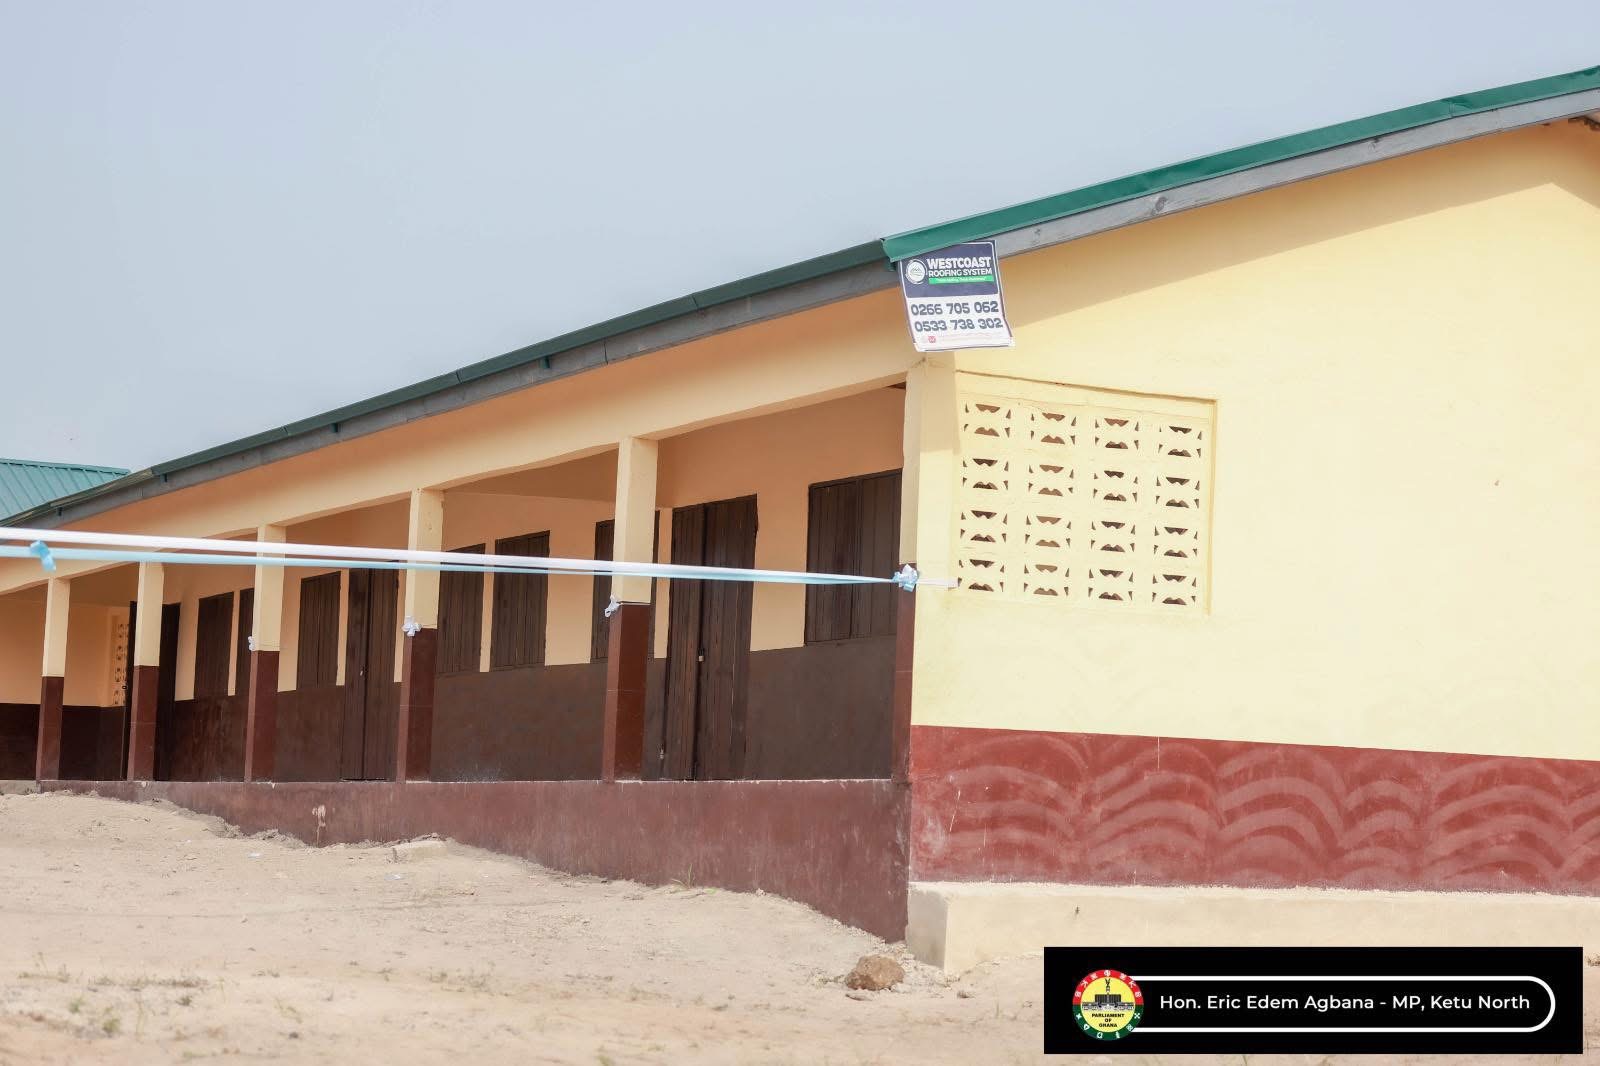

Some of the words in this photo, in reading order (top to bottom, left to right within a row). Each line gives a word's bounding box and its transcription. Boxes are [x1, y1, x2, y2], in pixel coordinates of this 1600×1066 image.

[926, 257, 991, 269] WESTCOAST
[928, 269, 962, 278] ROOFING
[963, 268, 992, 276] SYSTEM
[911, 304, 943, 316] 0266
[946, 303, 970, 315] 705
[974, 301, 999, 313] 062
[914, 320, 947, 332] 0533
[950, 319, 975, 330] 738
[978, 318, 1003, 329] 302
